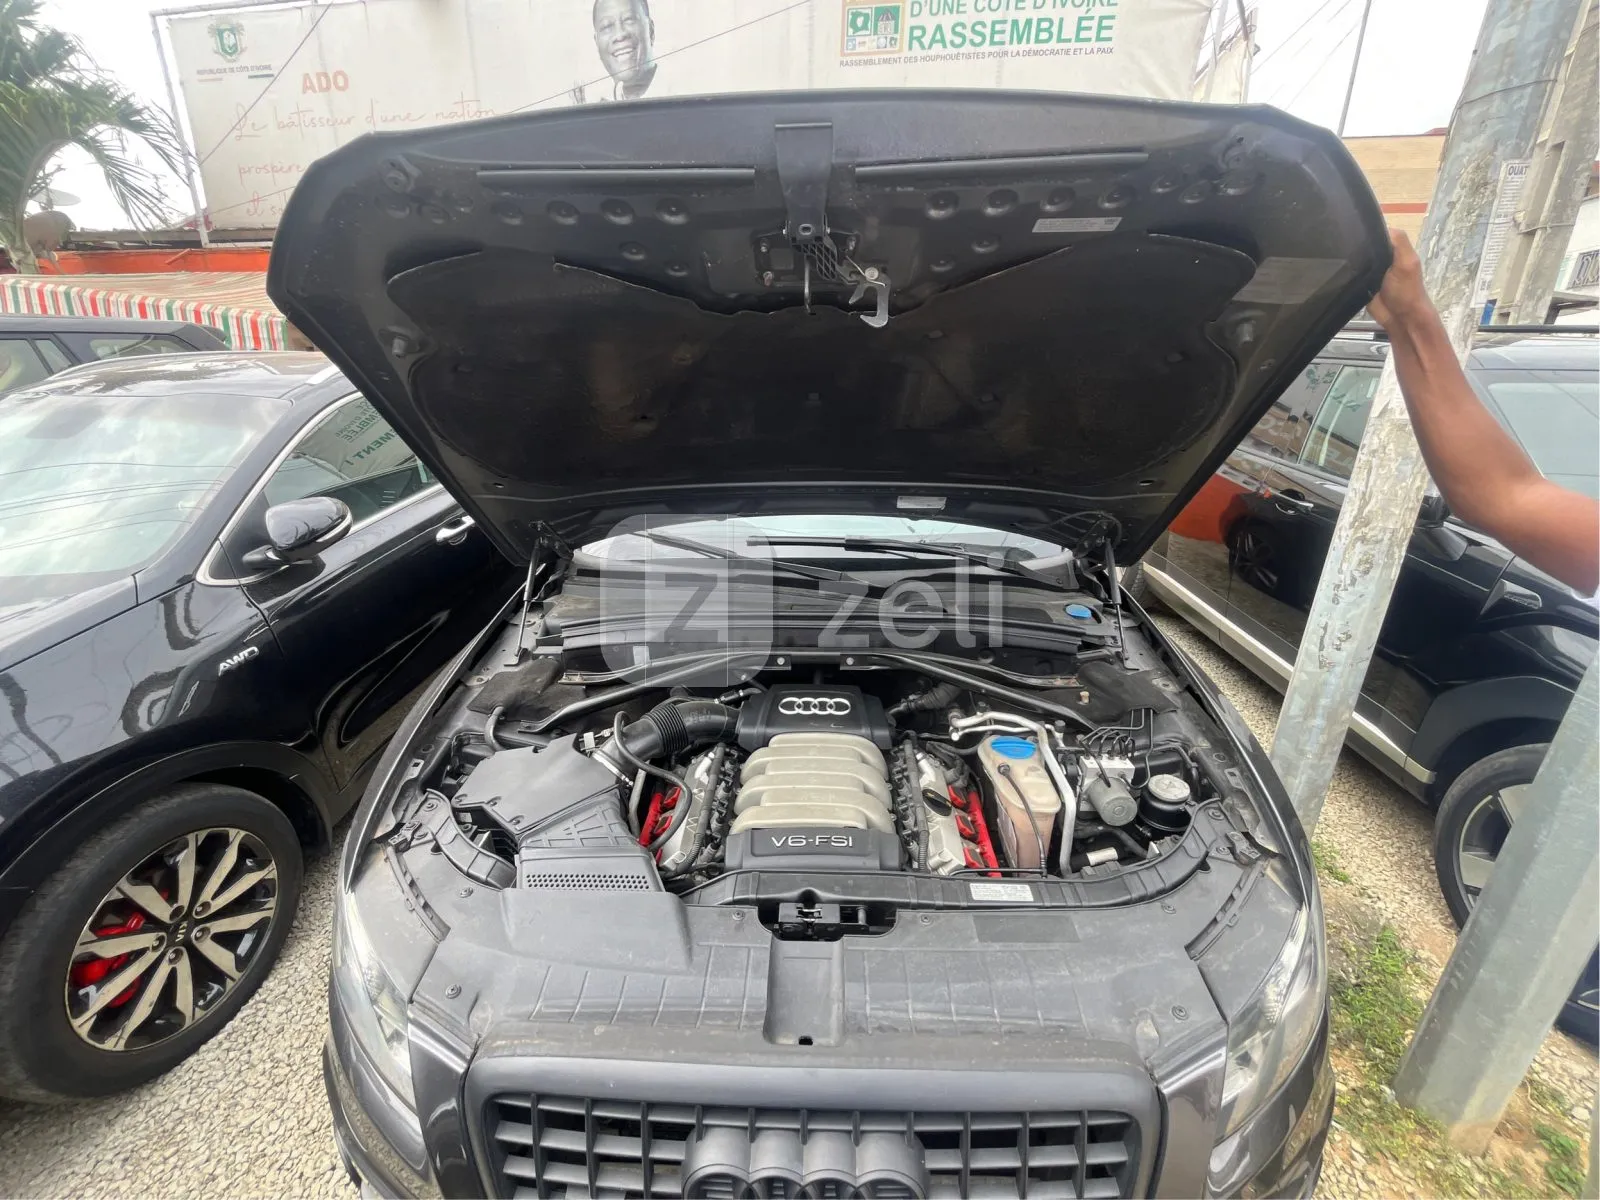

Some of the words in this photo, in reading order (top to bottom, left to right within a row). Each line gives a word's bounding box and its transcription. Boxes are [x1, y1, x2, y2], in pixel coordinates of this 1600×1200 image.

[910, 0, 967, 18] D'UNE
[908, 8, 1117, 51] RASSEMBLÉE
[840, 56, 902, 68] RASSEMBLEMENT
[903, 56, 918, 64] DES
[987, 50, 1009, 59] POUR
[1010, 50, 1021, 58] LA
[1022, 47, 1071, 57] DÉMOCRATIE
[1072, 47, 1083, 56] ET
[1084, 47, 1095, 55] LA
[1096, 46, 1115, 55] PAIX
[302, 70, 349, 94] ADO
[435, 91, 496, 120] nation
[218, 646, 260, 677] AWD
[771, 835, 853, 847] V6-FSI
